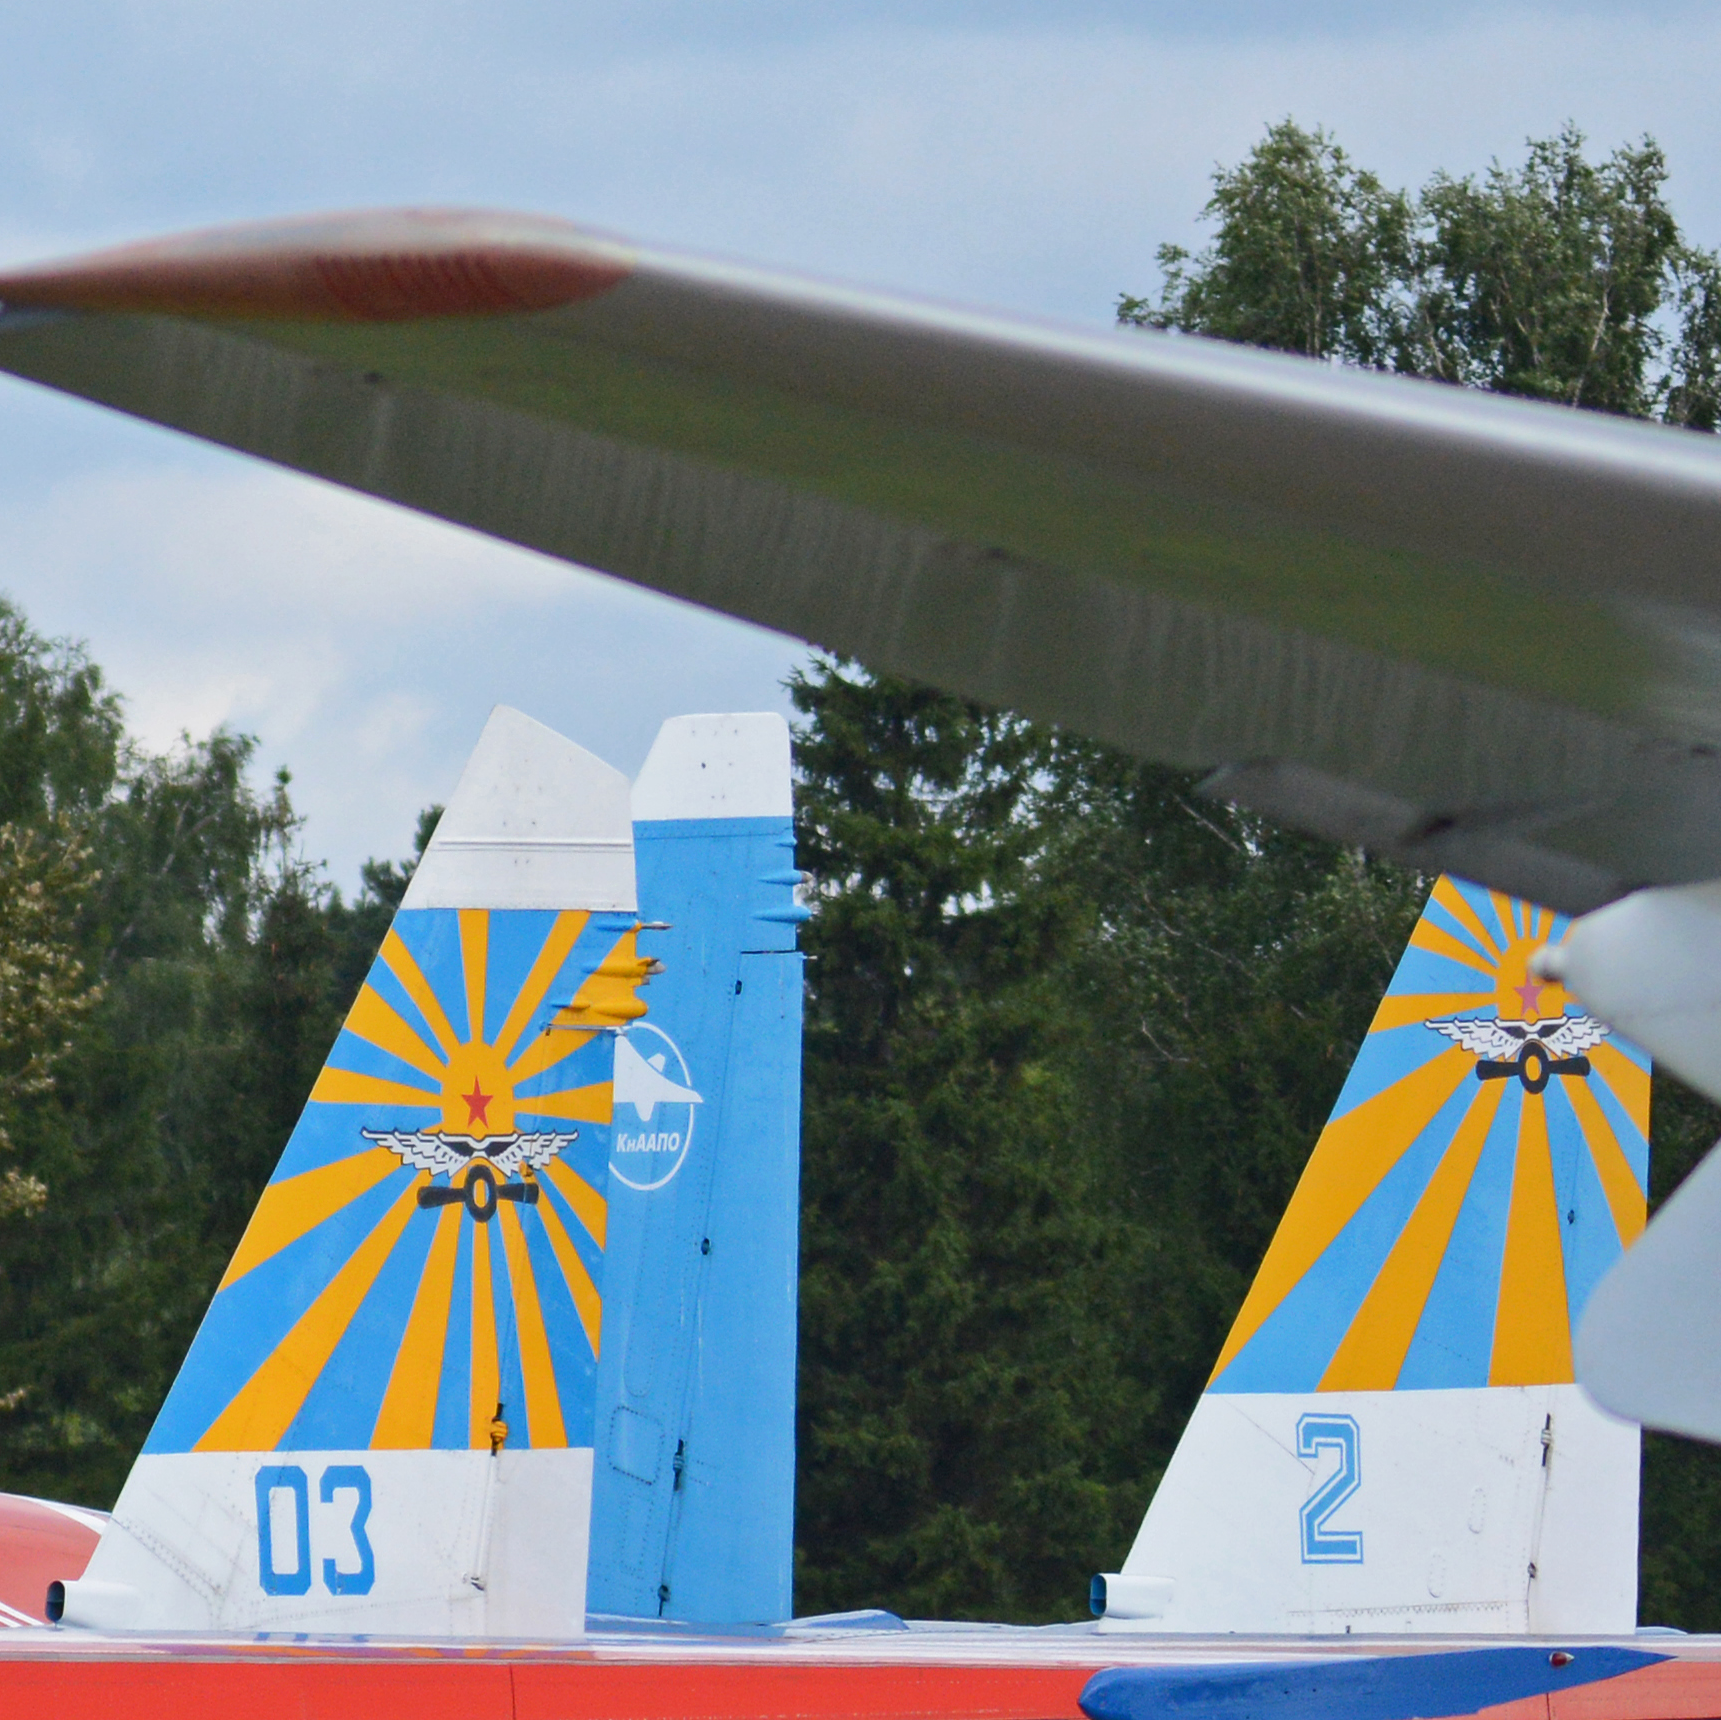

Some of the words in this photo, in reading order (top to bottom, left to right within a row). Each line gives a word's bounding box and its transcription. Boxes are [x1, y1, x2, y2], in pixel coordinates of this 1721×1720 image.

[616, 1132, 680, 1153] КнААПО
[254, 1464, 376, 1597] 03
[1296, 1412, 1364, 1565] 2
